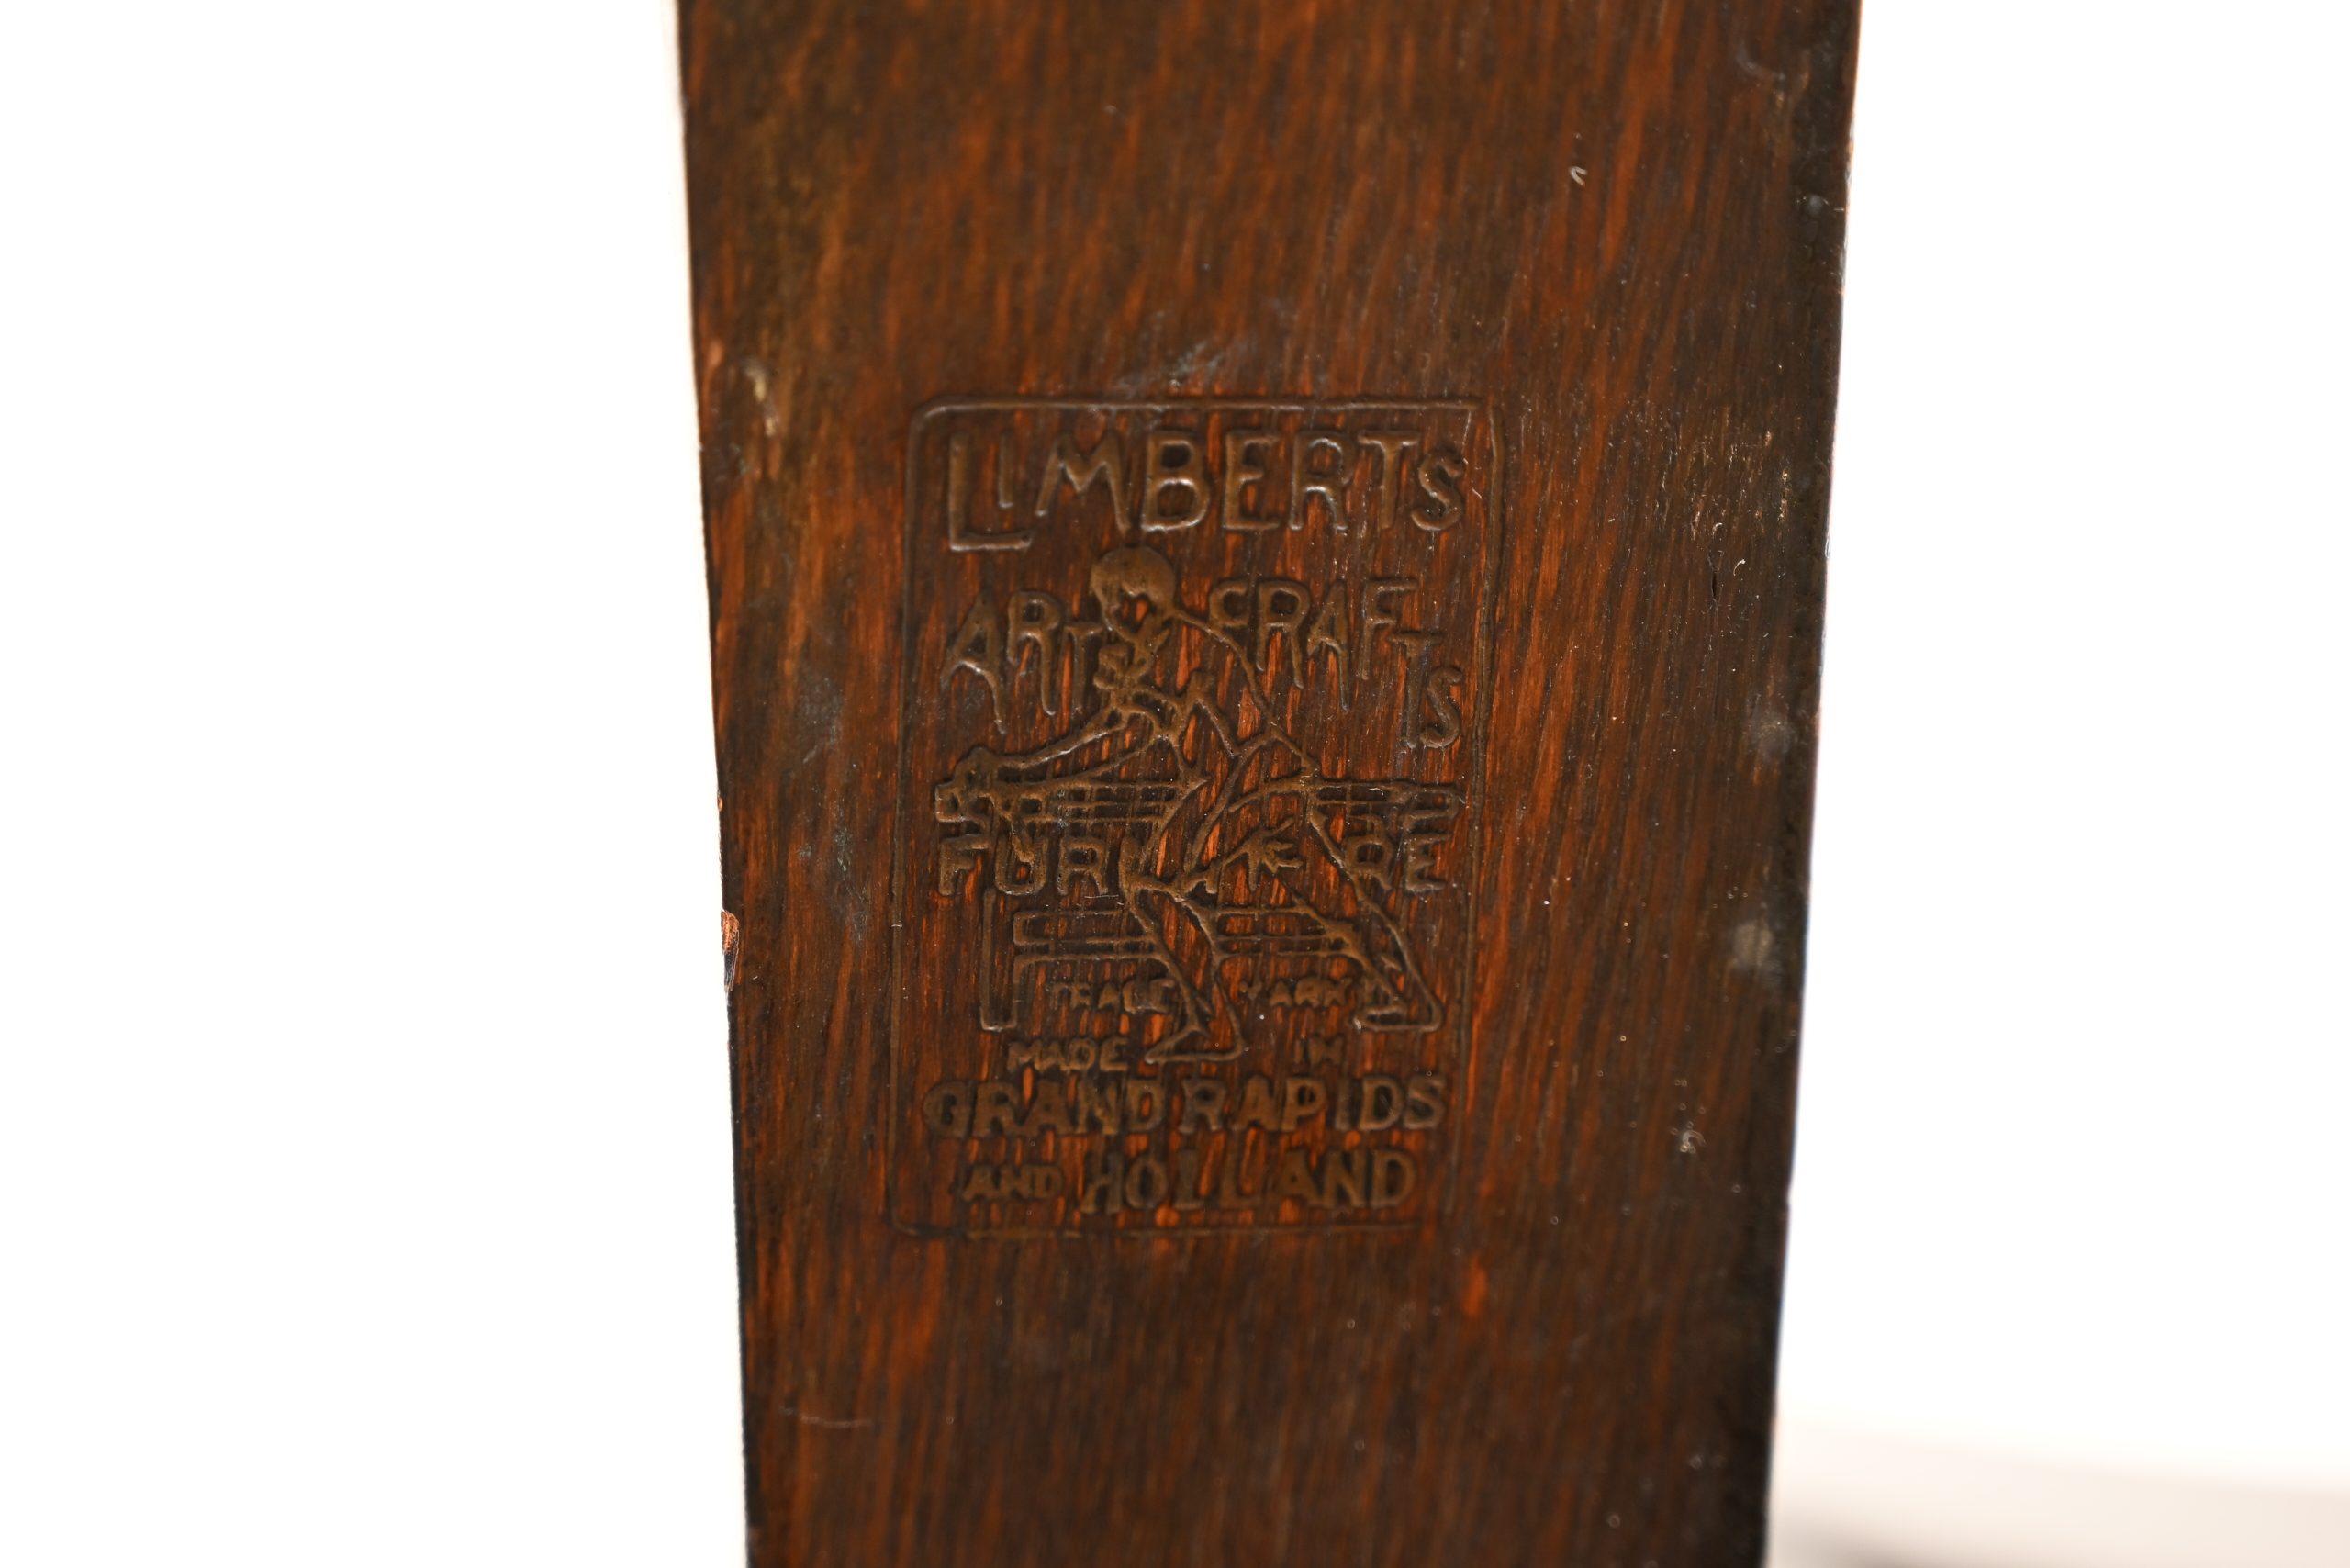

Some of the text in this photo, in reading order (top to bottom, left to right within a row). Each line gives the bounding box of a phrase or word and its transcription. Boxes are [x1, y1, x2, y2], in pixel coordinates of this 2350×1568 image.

[947, 430, 1466, 553] LIMBERTS
[1007, 1037, 1130, 1072] MADE
[923, 1073, 1448, 1138] GRAND RAPIDS
[961, 1148, 1417, 1215] AND HOLLAND
